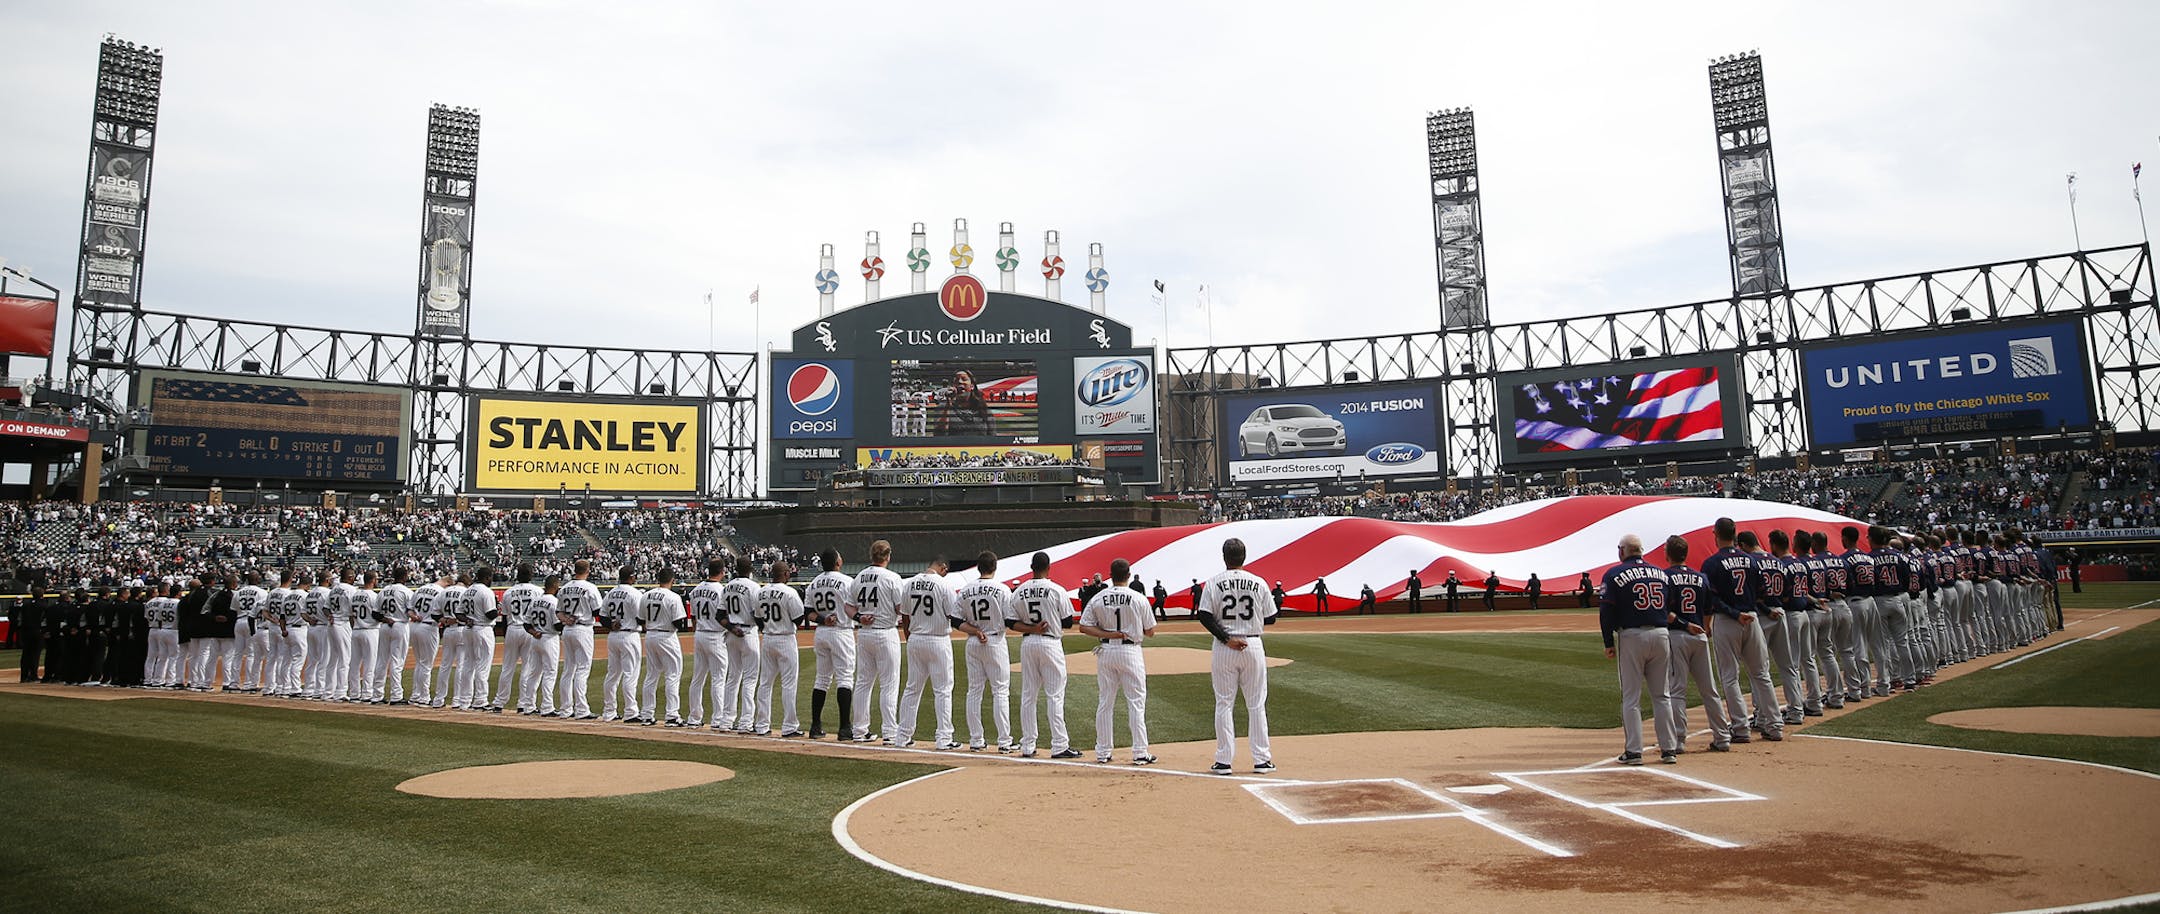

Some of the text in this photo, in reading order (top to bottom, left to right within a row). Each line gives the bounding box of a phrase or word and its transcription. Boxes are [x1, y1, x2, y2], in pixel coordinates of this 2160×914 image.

[98, 175, 139, 189] 1906
[94, 210, 136, 220] SERIES
[95, 203, 137, 215] WORLD
[431, 204, 466, 216] 2005
[95, 244, 131, 256] 1917
[87, 279, 131, 290] SERIES
[88, 273, 131, 284] WORLD
[425, 310, 461, 319] WORLD
[425, 316, 460, 324] SERIES
[908, 329, 1051, 345] U.S. Cellular Field
[1825, 353, 1998, 389] UNITED
[1340, 398, 1424, 414] 2014 FUSION
[1843, 391, 2050, 417] Proud to fly the Chicago White Sox
[790, 418, 837, 435] pepsi
[1081, 411, 1146, 428] IT'S Miller TIME
[7, 424, 67, 437] ON DEMAND
[489, 416, 687, 452] STANLEY
[154, 433, 207, 448] AT BAT 2
[240, 436, 279, 451] BALL 0
[291, 440, 341, 453] STRIKE 0
[354, 441, 384, 455] OUT 0
[785, 448, 840, 458] MUSCLE MILK
[1377, 446, 1414, 462] Ford
[488, 460, 679, 475] PERFORMANCE IN ACTION
[1239, 464, 1345, 475] LocalFordStores.com
[919, 472, 936, 483] THAT
[2065, 530, 2082, 539] BAR
[2094, 528, 2122, 538] PARTY
[2125, 526, 2156, 536] PORCH
[1721, 557, 1750, 571] MAUER
[860, 574, 878, 583] DUNN
[1671, 573, 1704, 588] DOZIER
[1732, 569, 1747, 595] 7
[1812, 571, 1826, 593] 31
[1827, 569, 1848, 590] 32
[1855, 564, 1875, 586] 25
[1880, 565, 1899, 586] 41
[816, 580, 842, 590] GARCIA
[911, 581, 935, 592] ABREU
[1216, 578, 1259, 593] VENTURA
[1793, 575, 1809, 598] 24
[771, 590, 785, 600] AZA
[857, 586, 879, 608] 44
[962, 586, 1001, 600] GILLASPIE
[1019, 587, 1050, 600] SEMIEN
[1103, 594, 1132, 606] EATON
[1632, 582, 1665, 610] 35
[1681, 587, 1696, 613] 2
[240, 597, 255, 611] 32
[269, 601, 281, 615] 65
[284, 602, 296, 616] 62
[306, 601, 317, 615] 55
[381, 599, 396, 613] 46
[414, 597, 431, 613] 45
[510, 599, 532, 616] 37
[563, 598, 579, 615] 27
[726, 595, 740, 614] 10
[814, 591, 836, 612] 26
[911, 594, 934, 617] 79
[1222, 595, 1254, 621] 23
[161, 610, 175, 623] 96
[352, 605, 366, 619] 50
[608, 602, 624, 620] 24
[646, 604, 661, 622] 17
[696, 601, 710, 620] 14
[760, 603, 781, 622] 30
[970, 598, 991, 621] 12
[1028, 601, 1042, 624] 5
[531, 611, 546, 627] 28
[1114, 608, 1121, 632] 1
